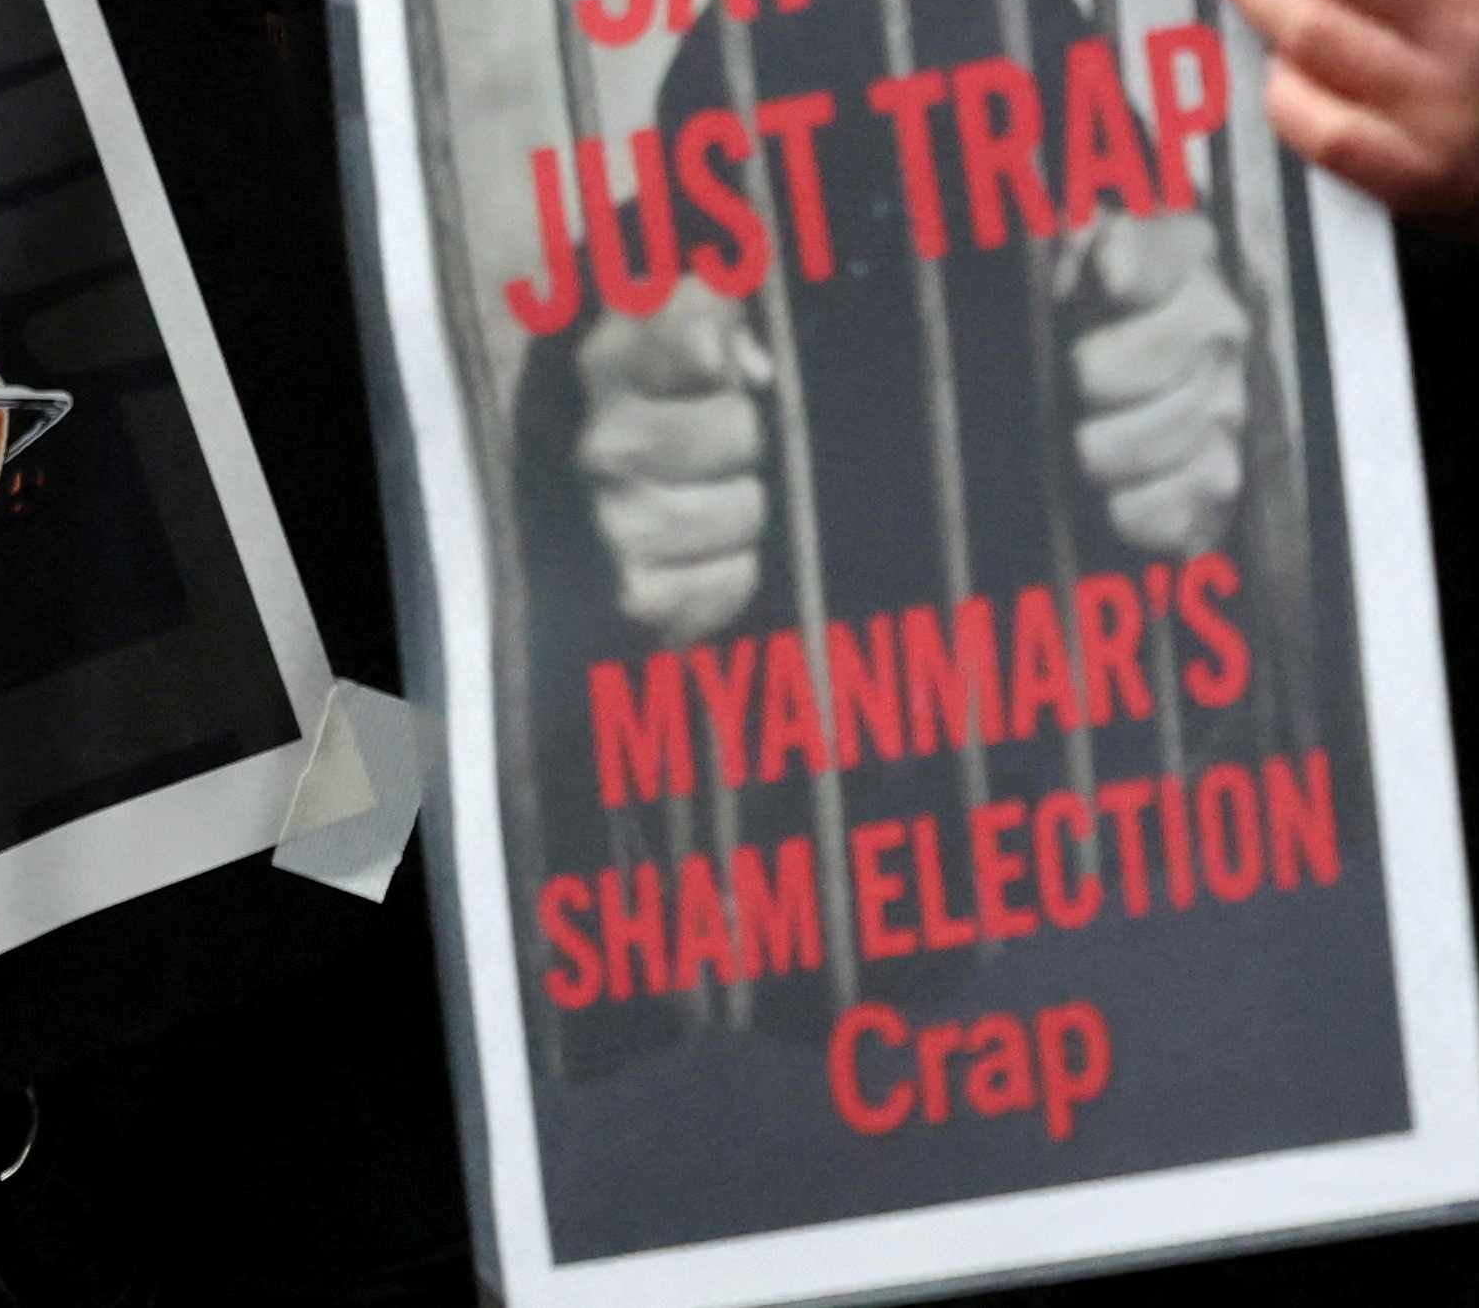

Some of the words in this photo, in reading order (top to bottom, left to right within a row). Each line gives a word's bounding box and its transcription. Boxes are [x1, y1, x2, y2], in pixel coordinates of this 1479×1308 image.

[504, 90, 836, 336] JUST
[869, 23, 1229, 261] TRAP
[587, 549, 1253, 810] MYANMAR'S
[535, 834, 827, 1010] SHAM
[849, 747, 1342, 961] ELECTION
[828, 996, 1113, 1142] Crap
